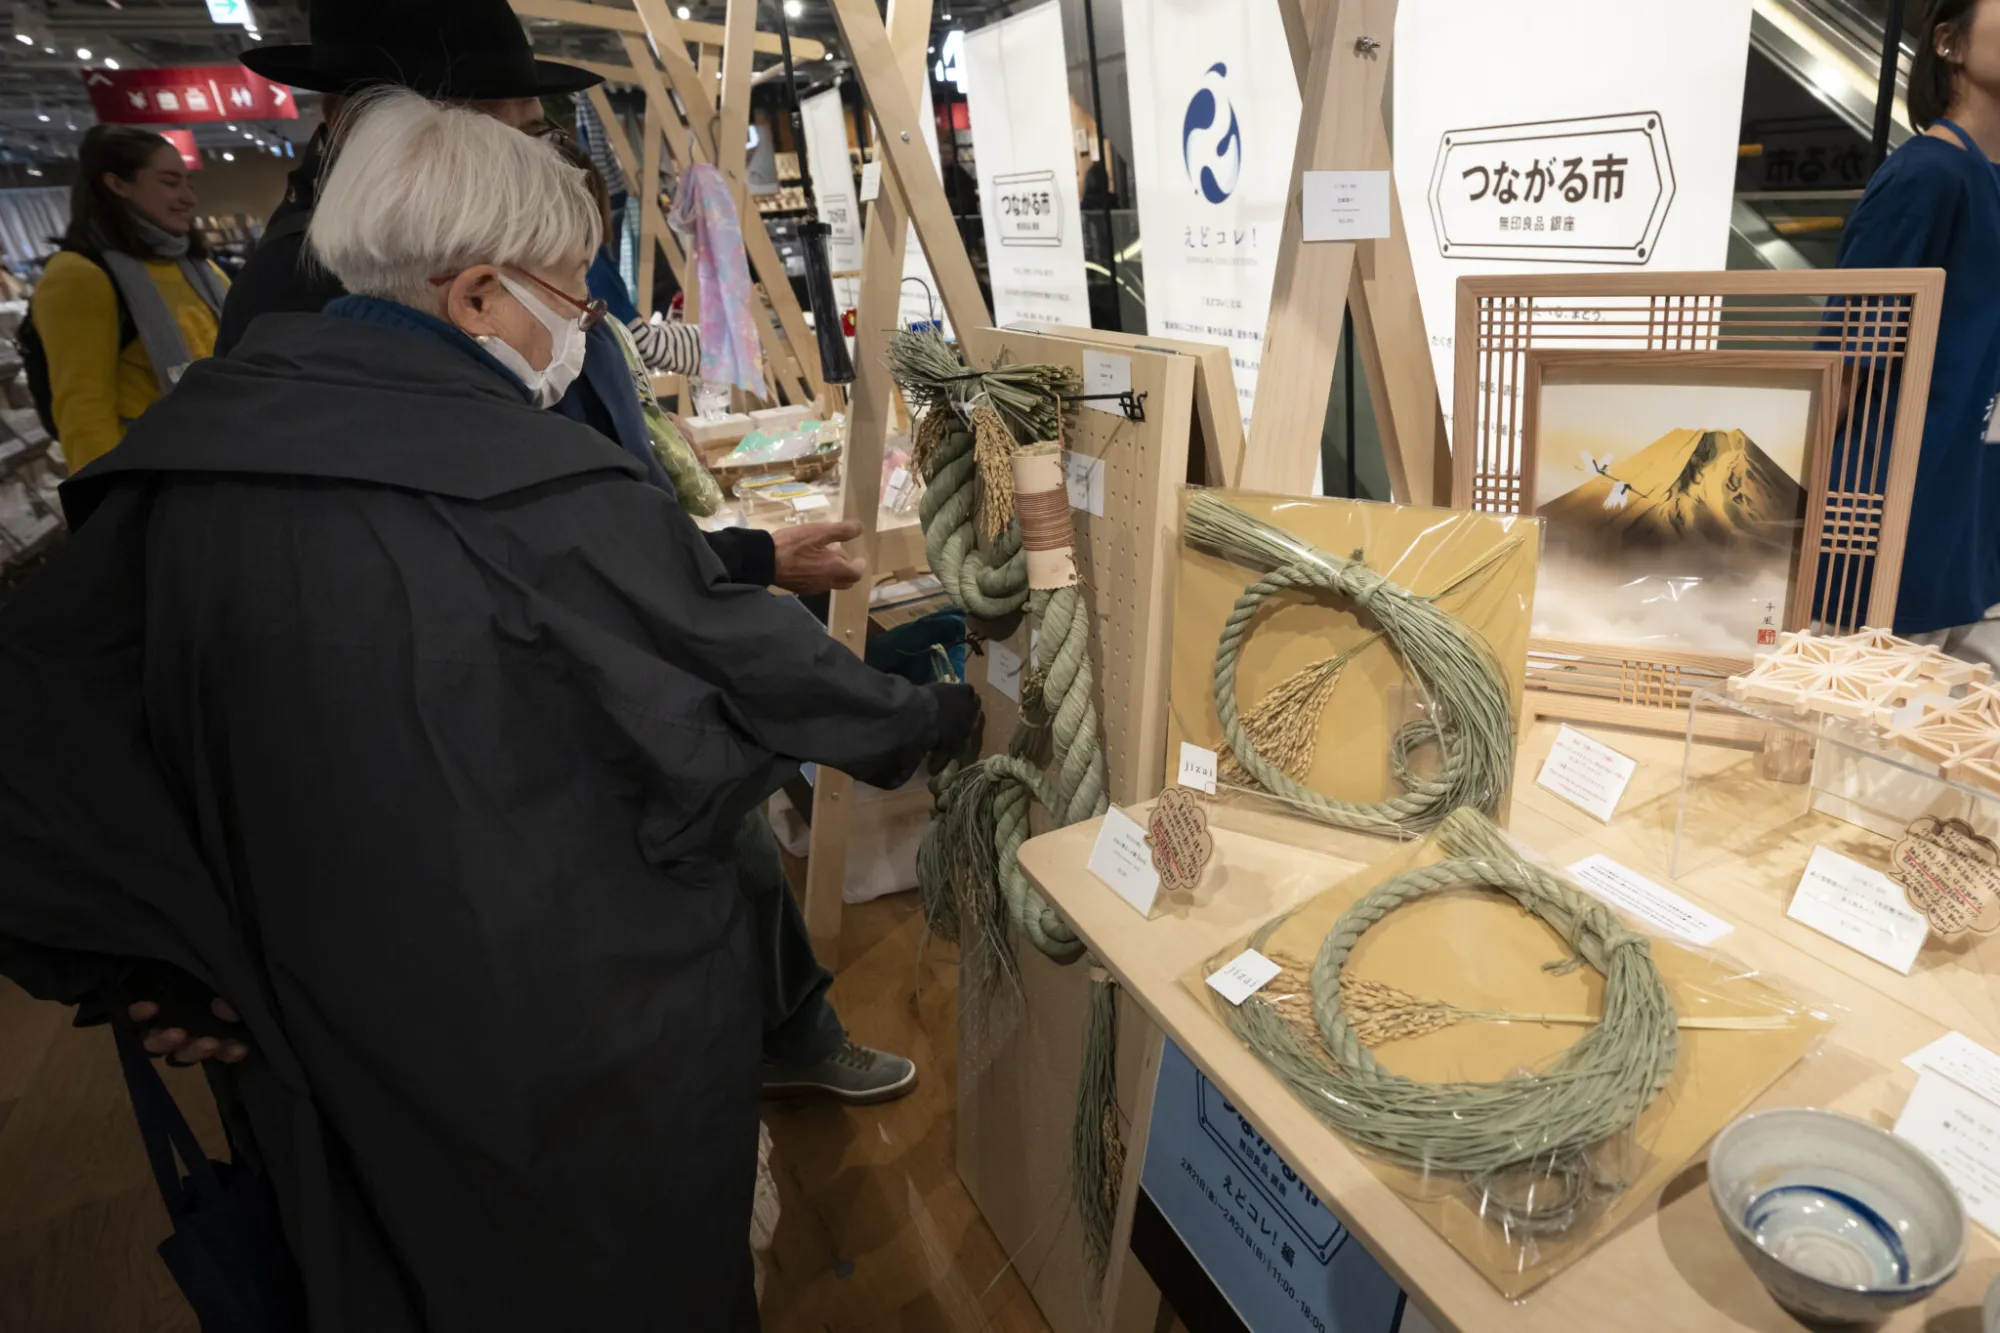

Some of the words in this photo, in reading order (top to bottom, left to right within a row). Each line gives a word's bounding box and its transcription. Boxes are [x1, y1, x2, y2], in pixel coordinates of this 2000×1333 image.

[1462, 153, 1628, 204] つながる市
[1184, 760, 1213, 777] jizai
